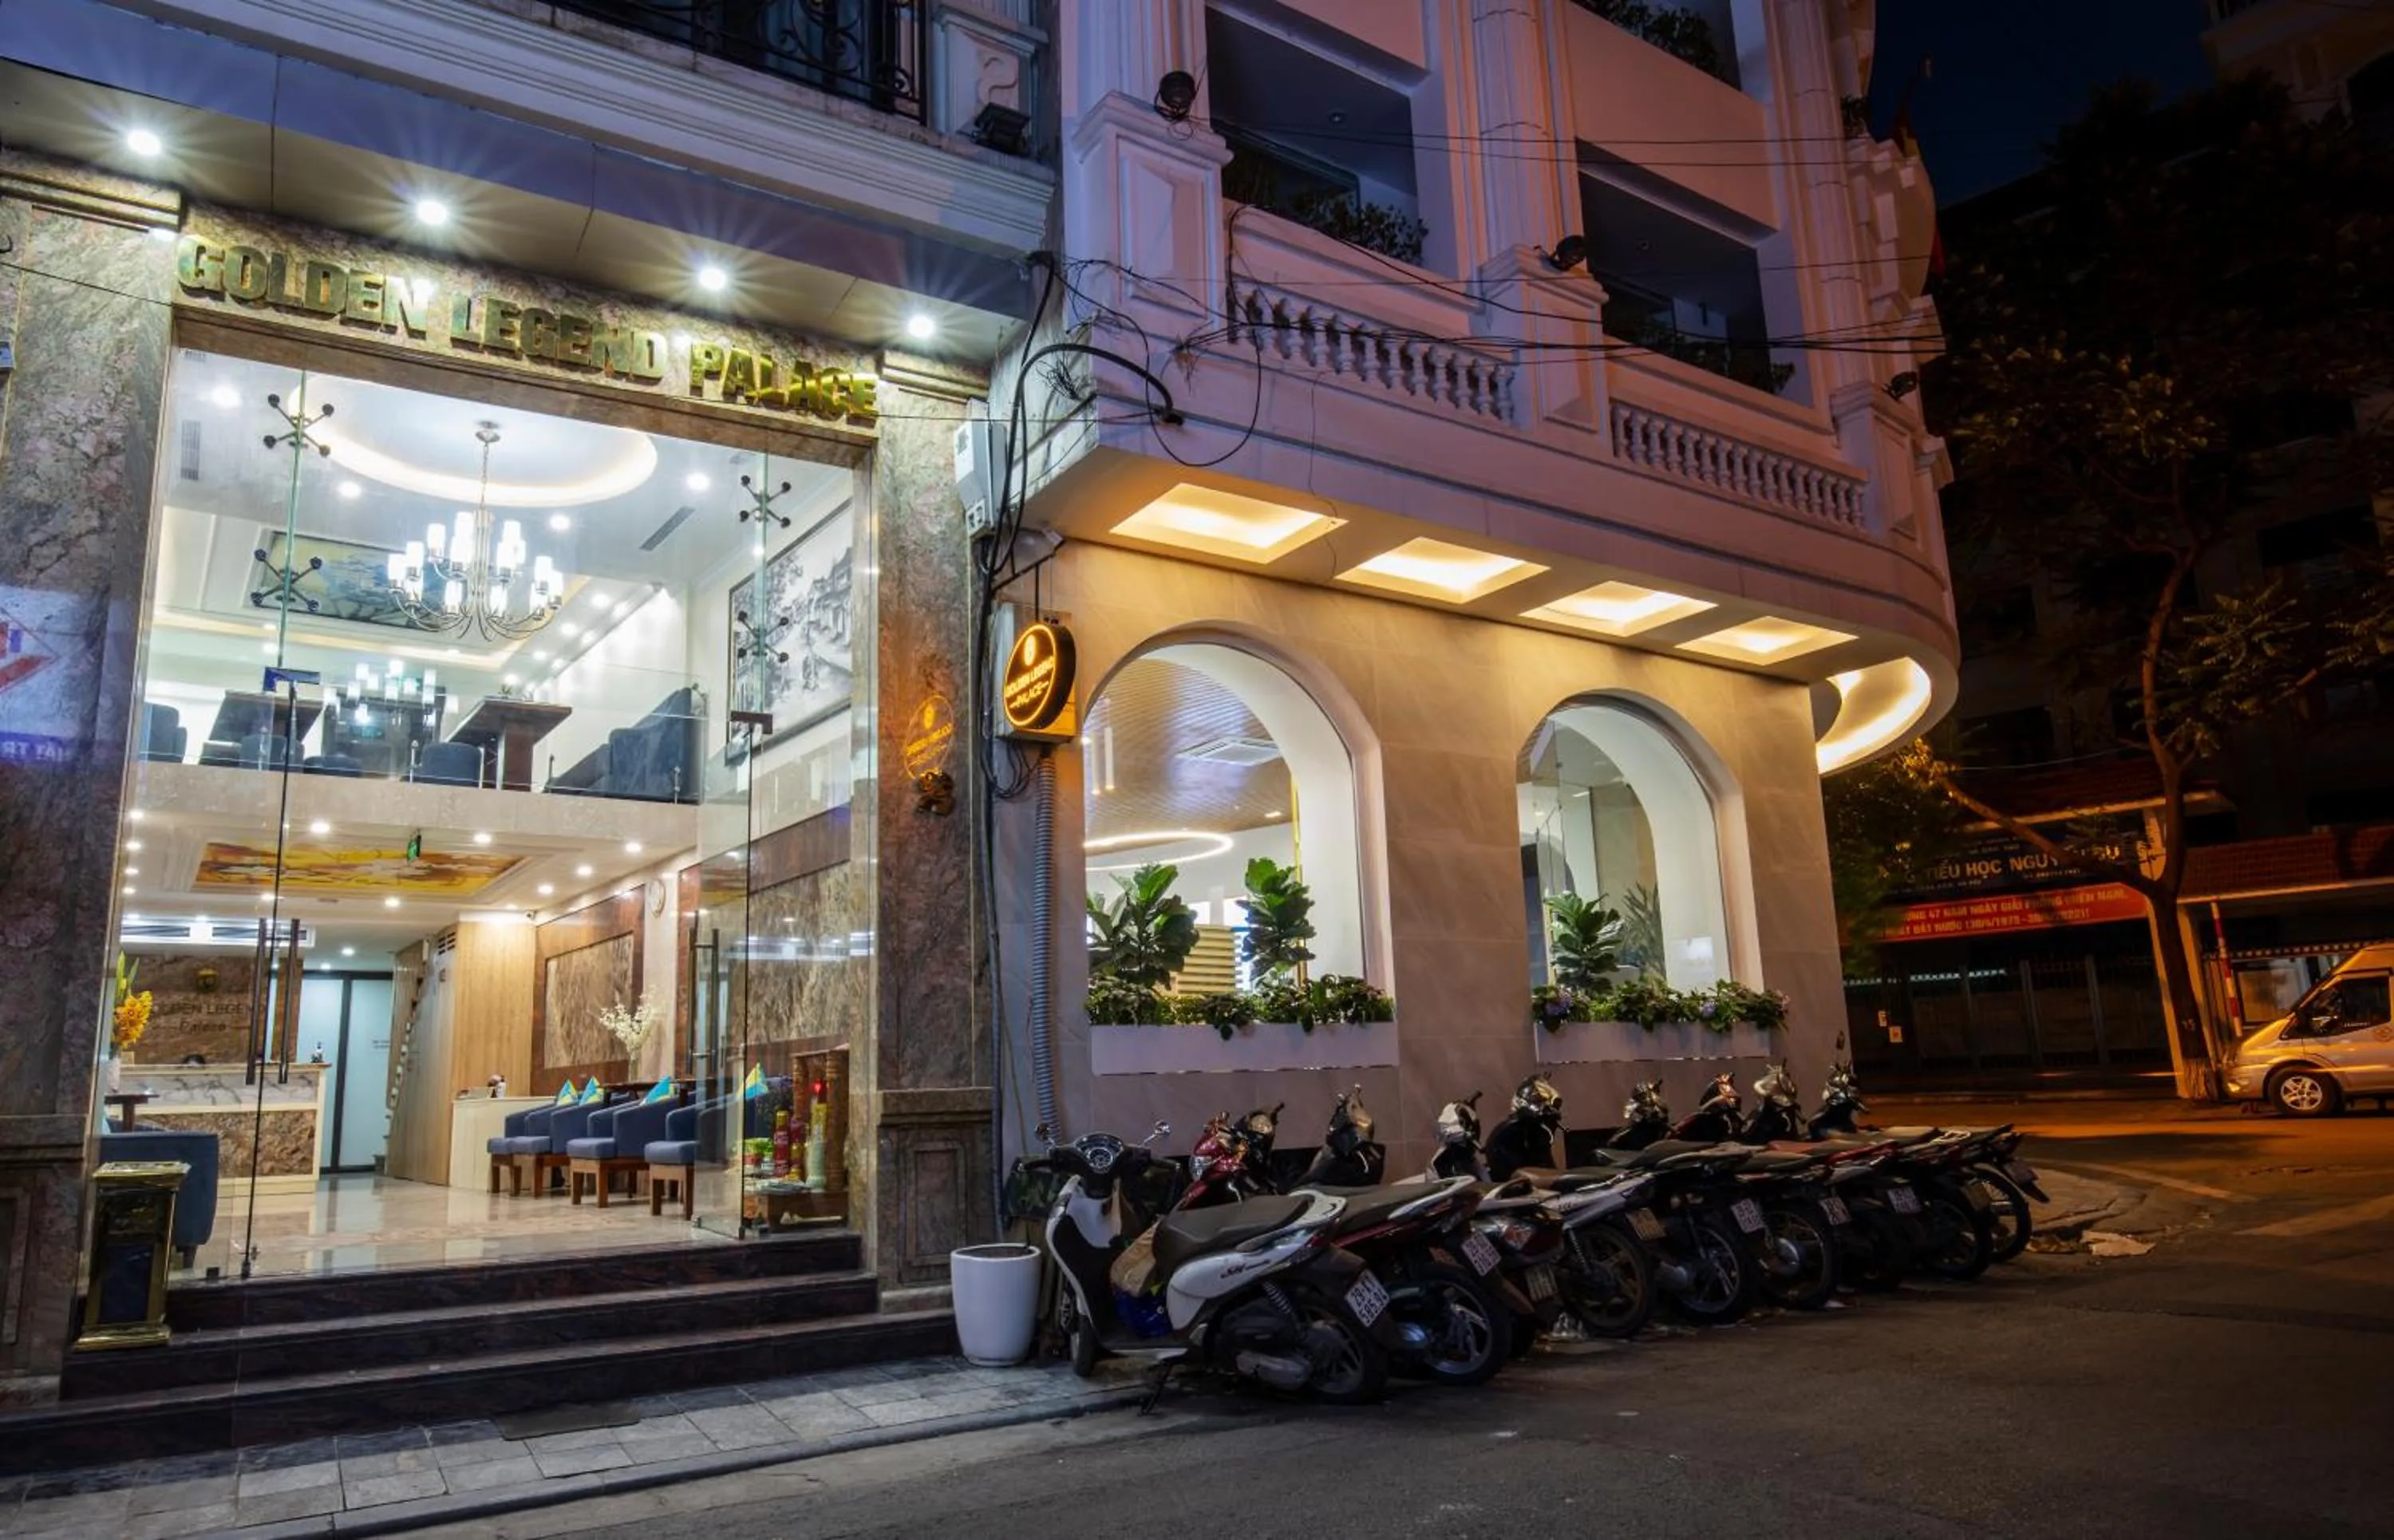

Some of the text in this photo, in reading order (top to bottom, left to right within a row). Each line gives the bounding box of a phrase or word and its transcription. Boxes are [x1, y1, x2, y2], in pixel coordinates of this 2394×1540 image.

[176, 234, 879, 418] GOLDEN LEGEND PALACE
[1965, 859, 2002, 879] HỌC
